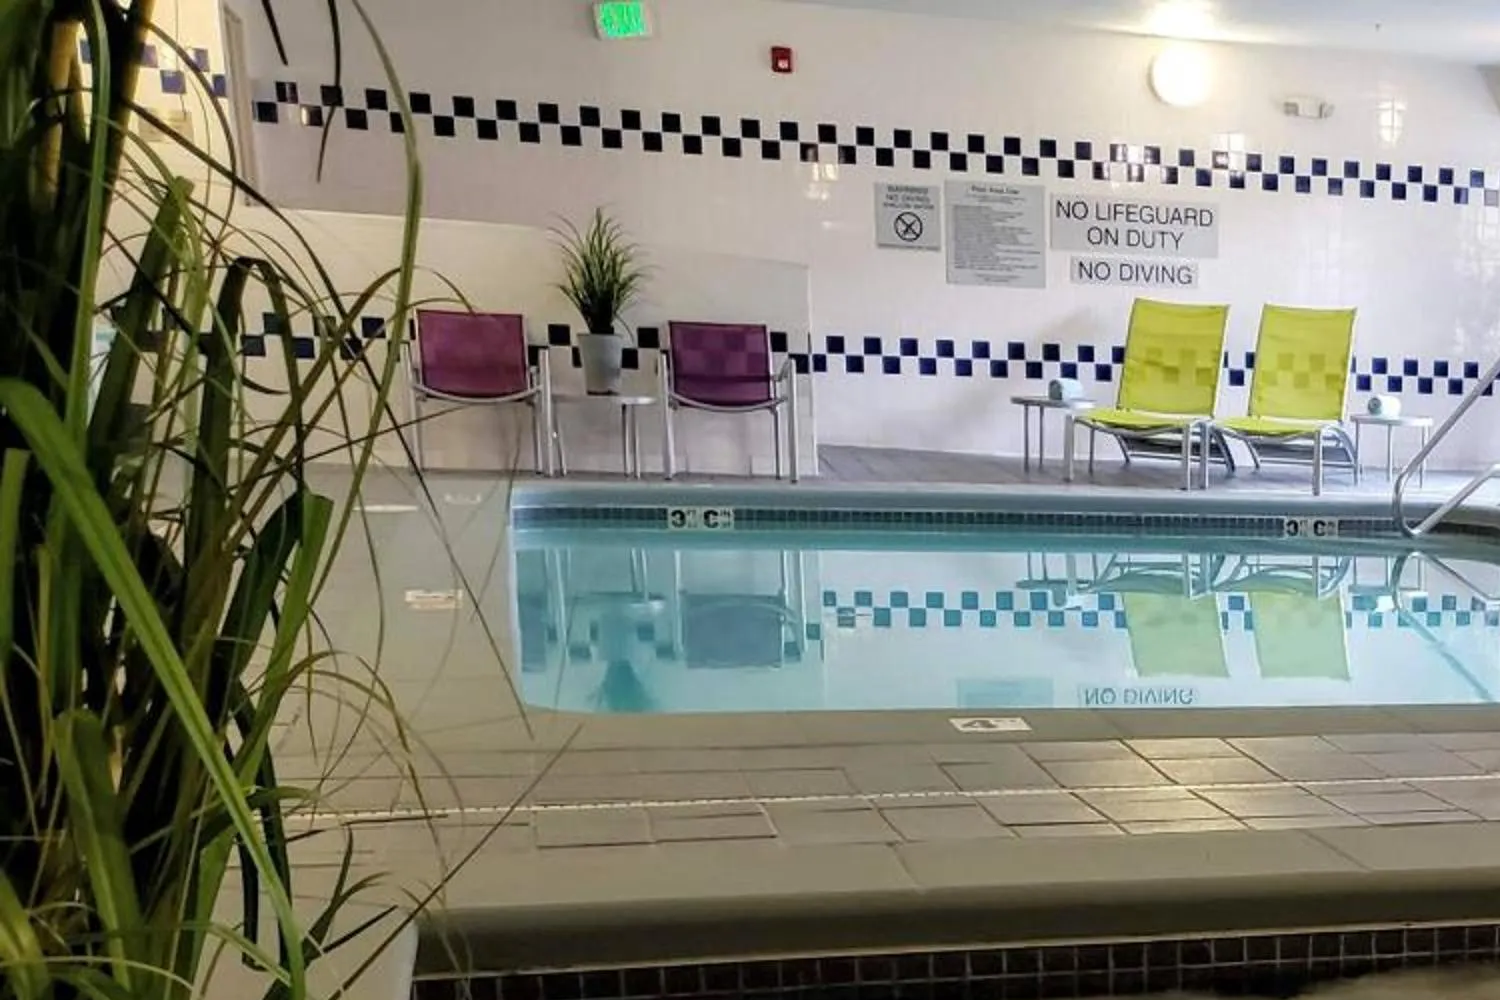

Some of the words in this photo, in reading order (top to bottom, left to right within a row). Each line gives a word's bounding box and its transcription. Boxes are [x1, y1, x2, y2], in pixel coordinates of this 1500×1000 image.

[1056, 200, 1088, 220] NO
[1095, 203, 1213, 227] LIFEGUARD
[1087, 226, 1119, 246] ON
[1126, 229, 1184, 250] DUTY
[1078, 261, 1111, 281] NO
[1119, 263, 1192, 285] DIVING
